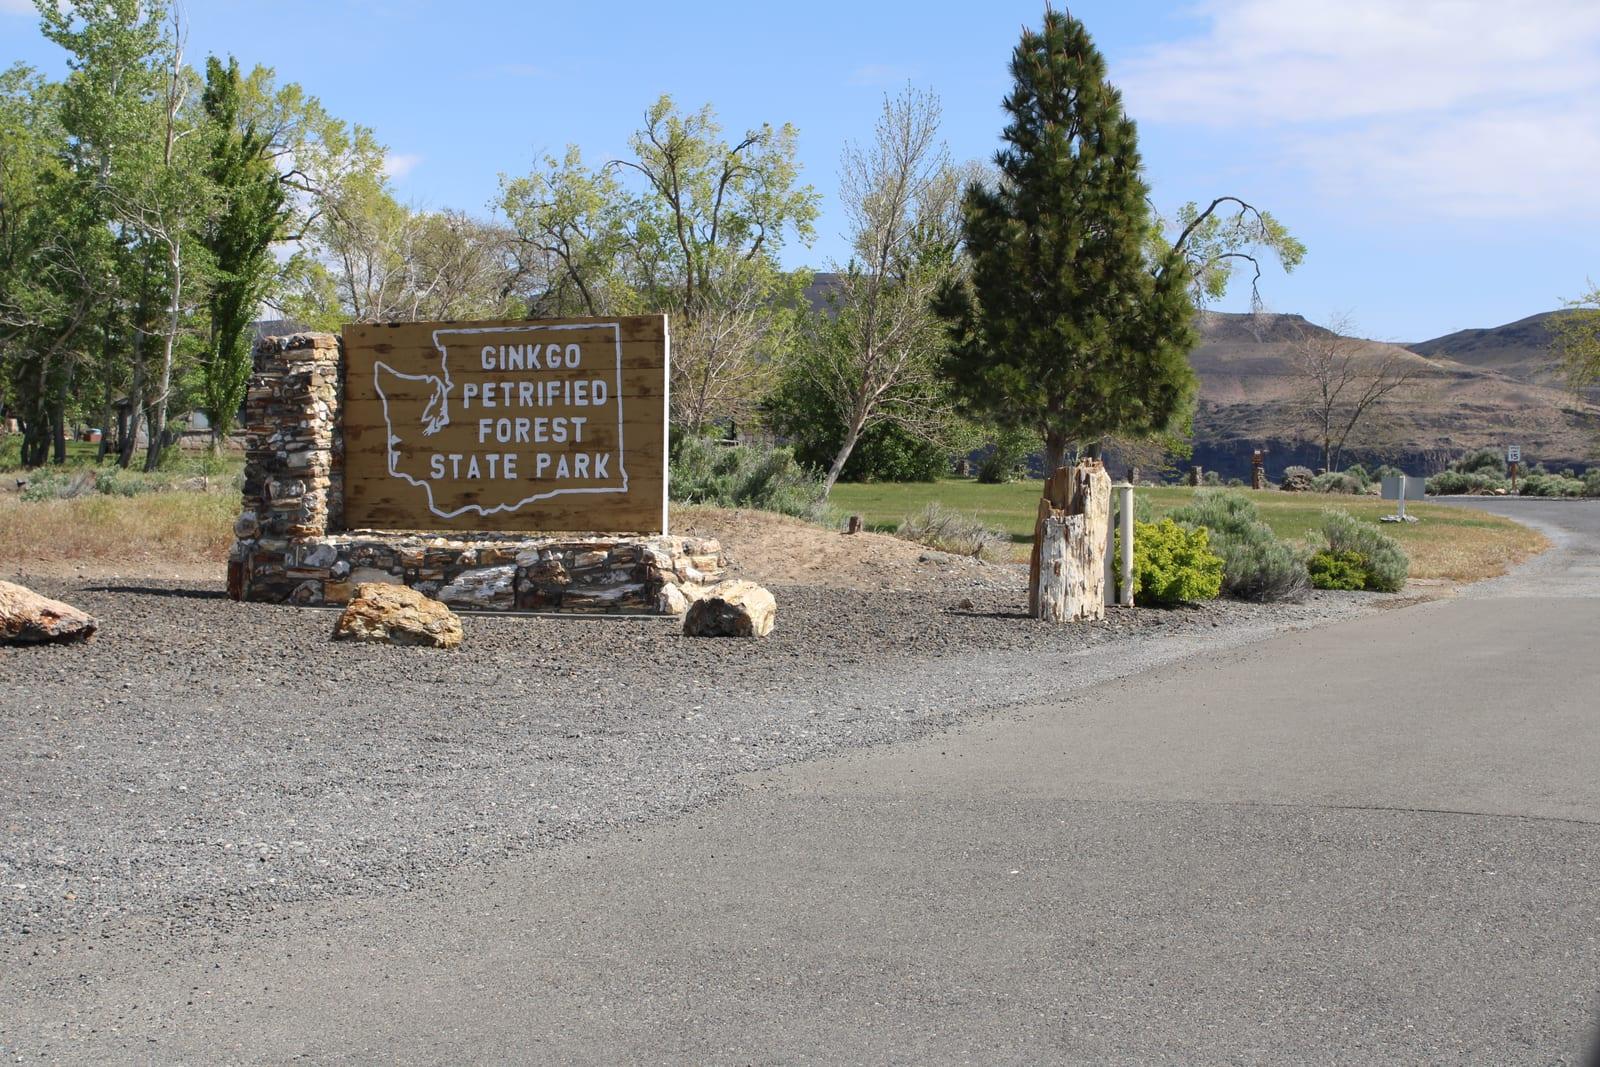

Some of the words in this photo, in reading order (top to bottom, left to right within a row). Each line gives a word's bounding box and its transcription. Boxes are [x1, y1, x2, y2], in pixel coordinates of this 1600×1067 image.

[481, 343, 581, 370] GINKGO
[463, 380, 608, 408] PETRIFIED
[479, 416, 588, 443] FOREST
[430, 453, 518, 479] STATE
[536, 453, 610, 479] PARK
